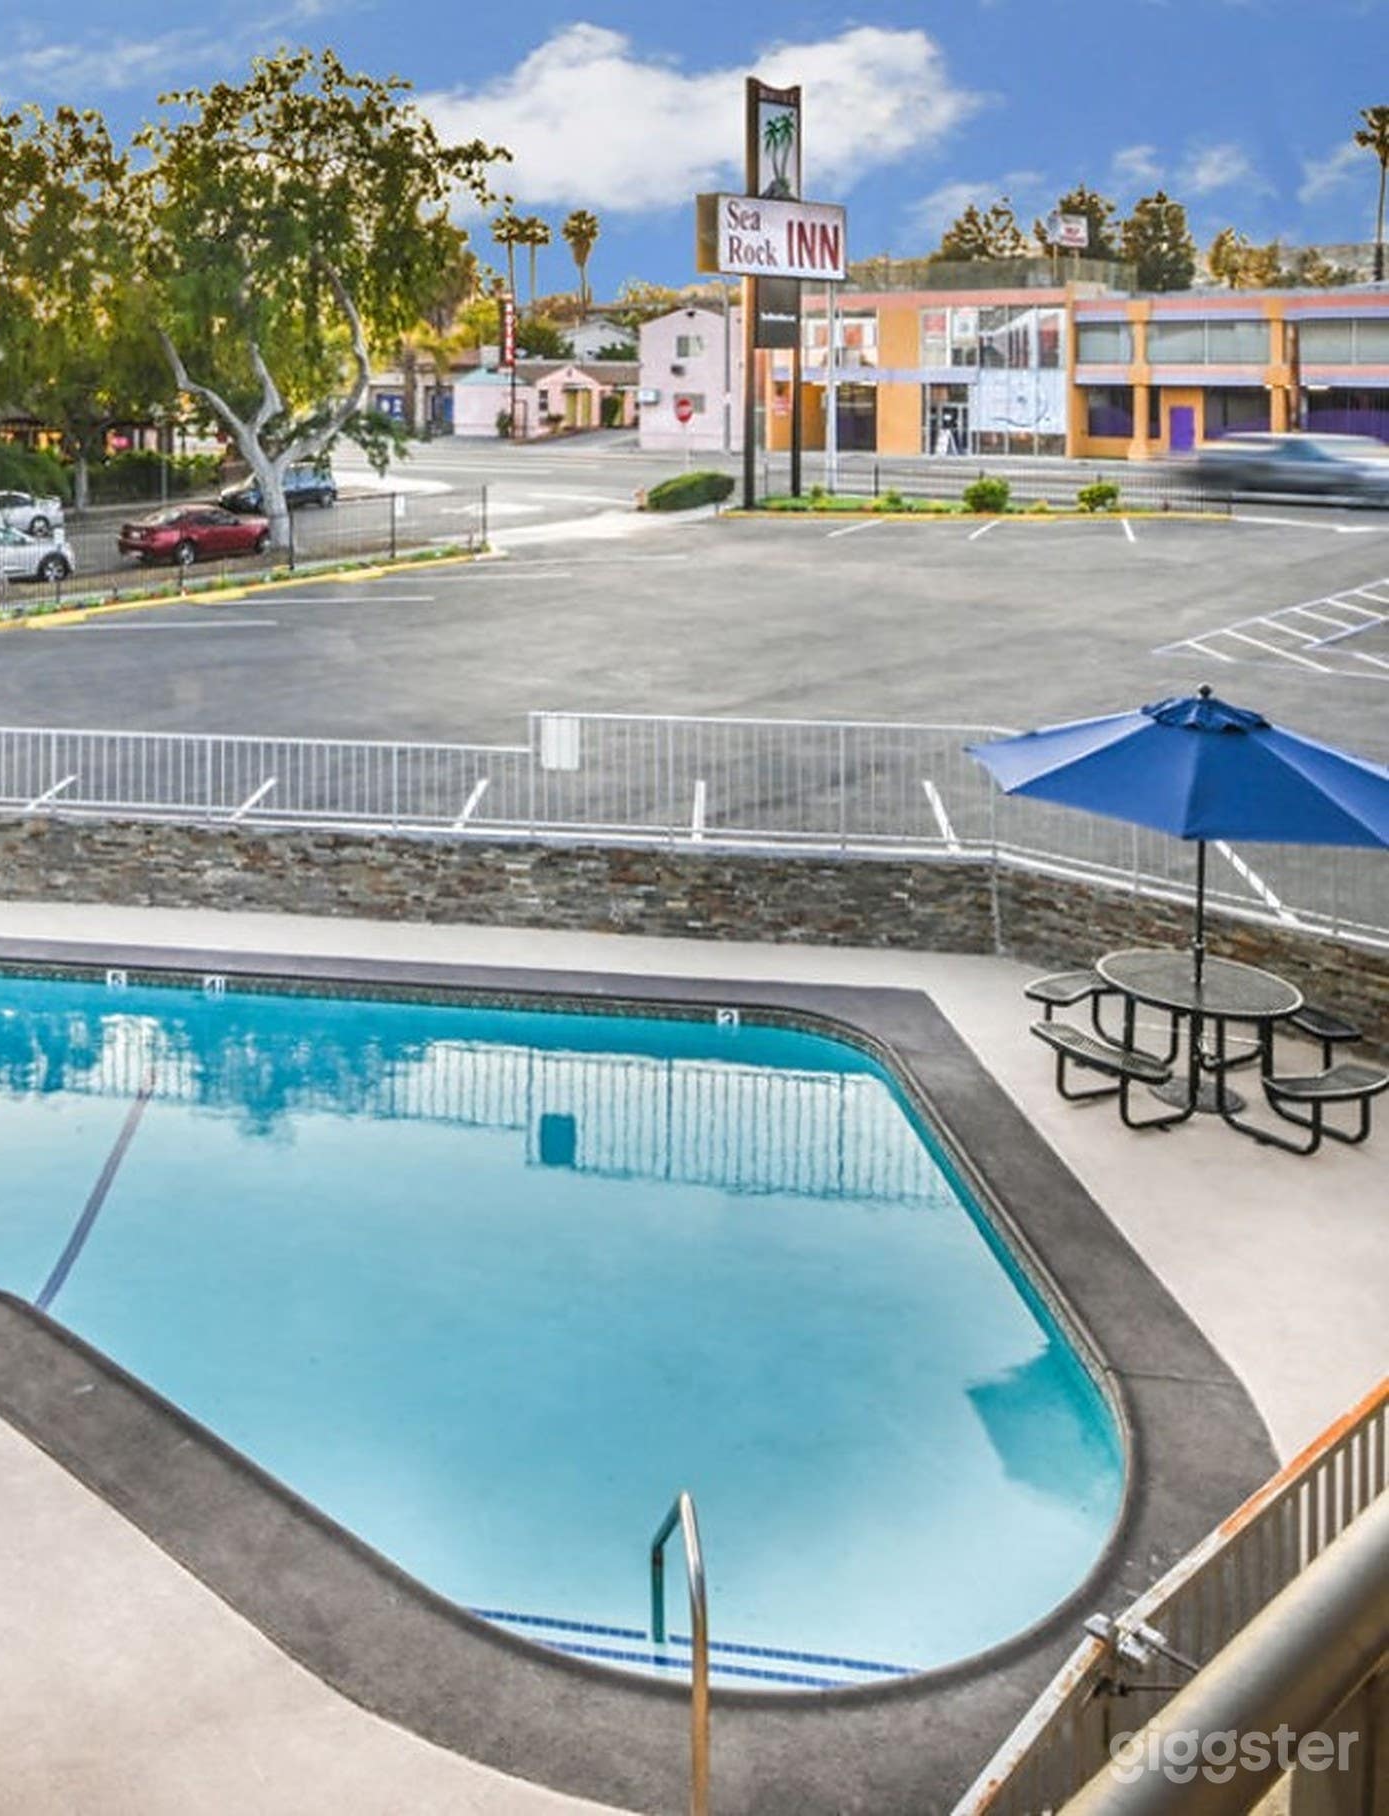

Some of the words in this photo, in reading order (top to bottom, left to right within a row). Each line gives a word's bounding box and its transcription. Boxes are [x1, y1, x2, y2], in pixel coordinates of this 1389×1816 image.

[727, 200, 760, 231] Sea
[729, 236, 778, 267] Rock
[787, 219, 839, 271] INN
